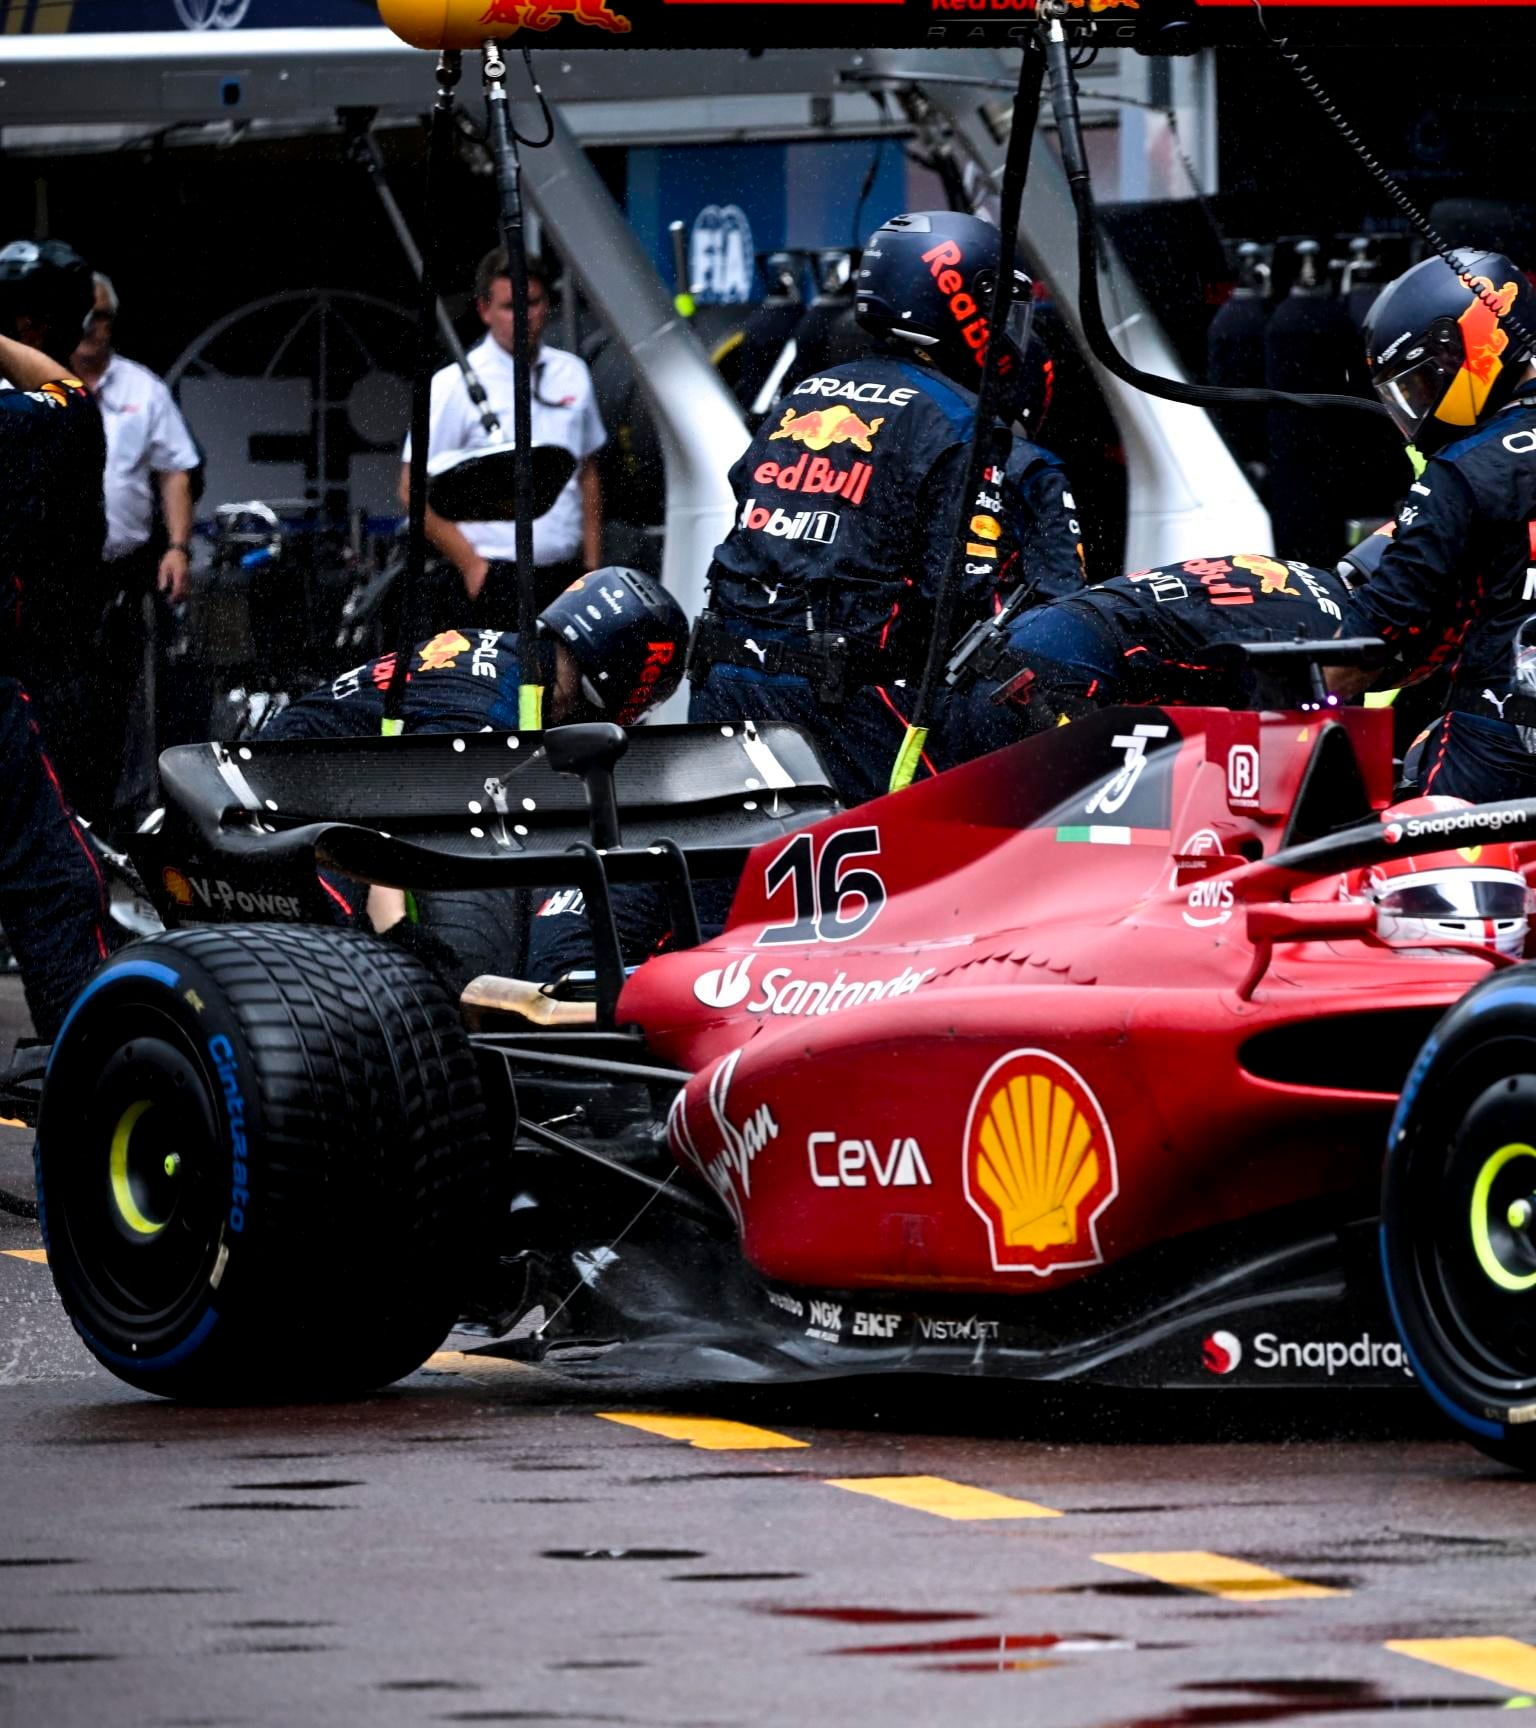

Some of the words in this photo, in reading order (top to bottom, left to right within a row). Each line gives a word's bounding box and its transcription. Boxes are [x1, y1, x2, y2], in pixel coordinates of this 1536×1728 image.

[927, 26, 1136, 38] RACNG
[793, 377, 920, 407] ORACLE
[753, 453, 810, 493] ed
[801, 456, 875, 505] Bull
[1407, 810, 1527, 837] Snapdragon
[188, 876, 301, 918] V-Power
[752, 825, 887, 947] 16
[1188, 880, 1235, 909] aws
[747, 965, 938, 1019] Santander
[208, 1033, 254, 1233] Cinturato
[853, 1312, 902, 1338] SKF
